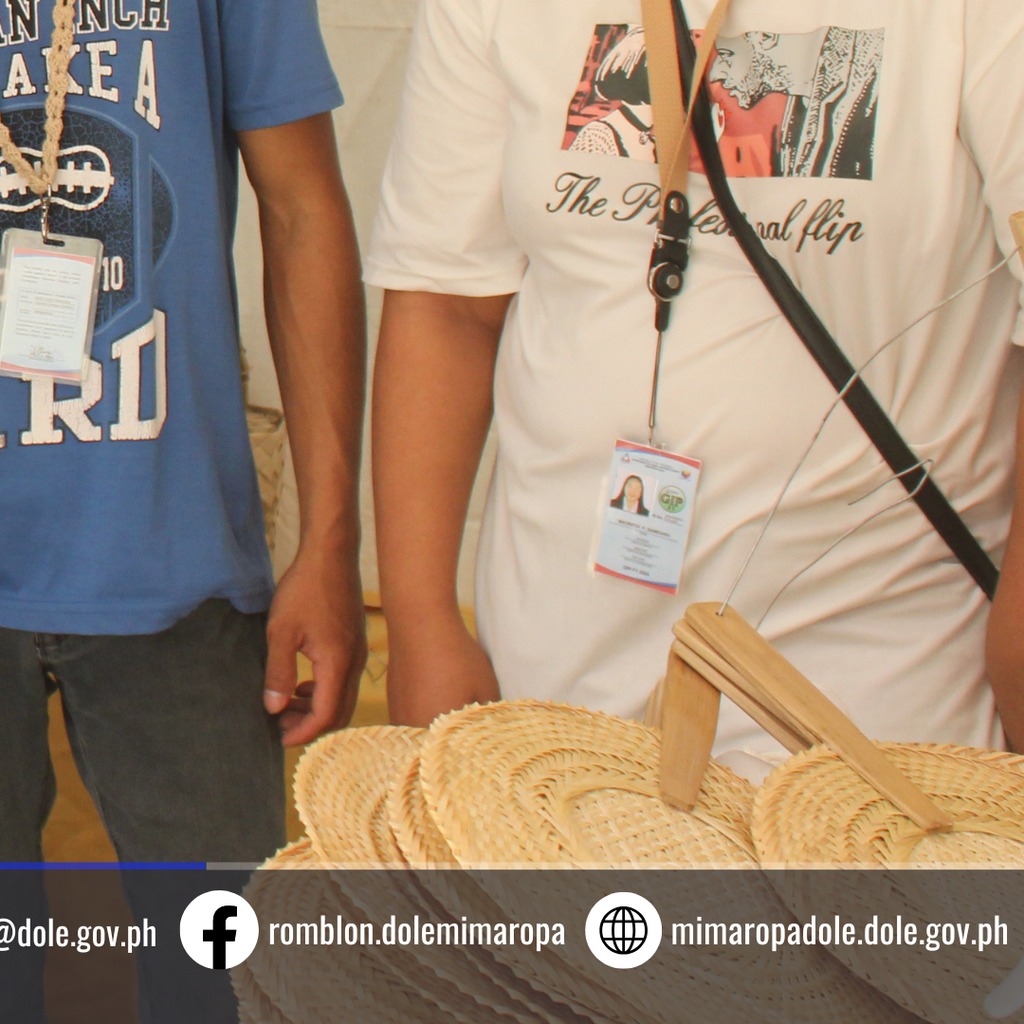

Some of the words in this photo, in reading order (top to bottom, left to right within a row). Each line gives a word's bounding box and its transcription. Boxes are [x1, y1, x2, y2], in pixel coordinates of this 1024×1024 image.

[134, 39, 161, 130] A
[546, 171, 609, 217] The
[794, 198, 865, 255] flip
[102, 255, 124, 292] 10
[661, 493, 684, 507] GIP
